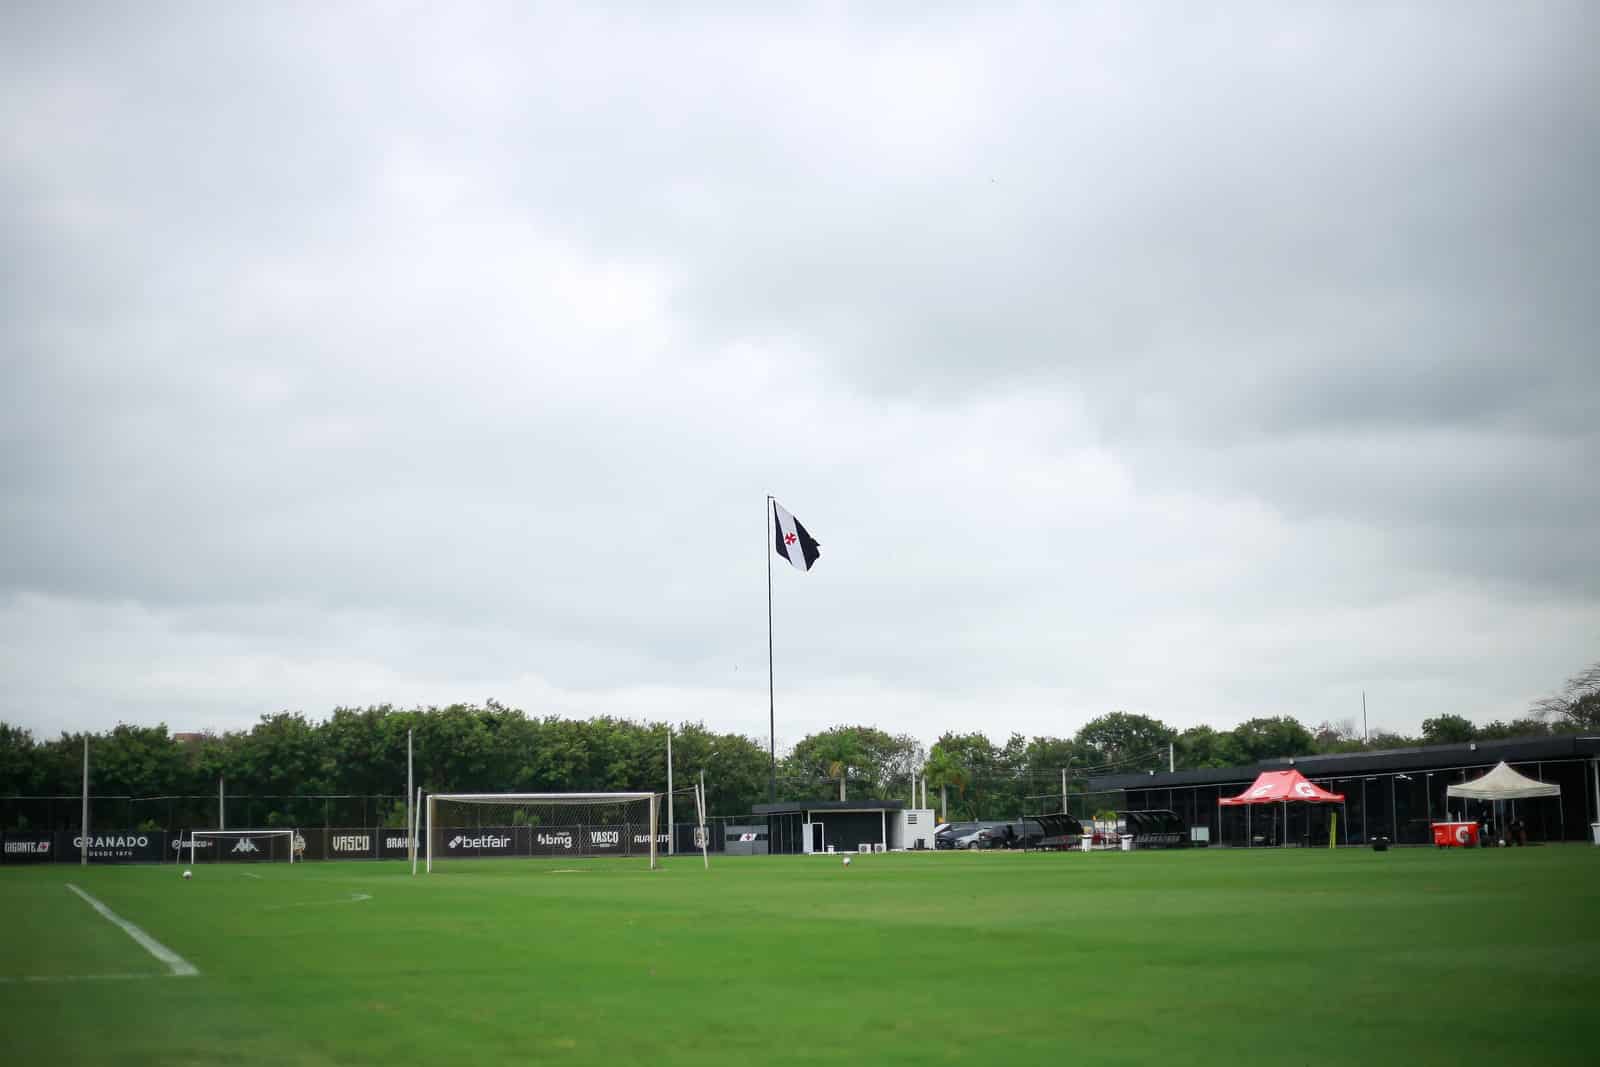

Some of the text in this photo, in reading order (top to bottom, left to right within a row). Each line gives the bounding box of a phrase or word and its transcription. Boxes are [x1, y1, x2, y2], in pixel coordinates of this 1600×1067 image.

[73, 836, 149, 848] GRANADO
[333, 836, 370, 851] VASCO
[463, 835, 511, 848] betfair
[546, 833, 573, 849] bmg
[591, 831, 619, 843] VASCO
